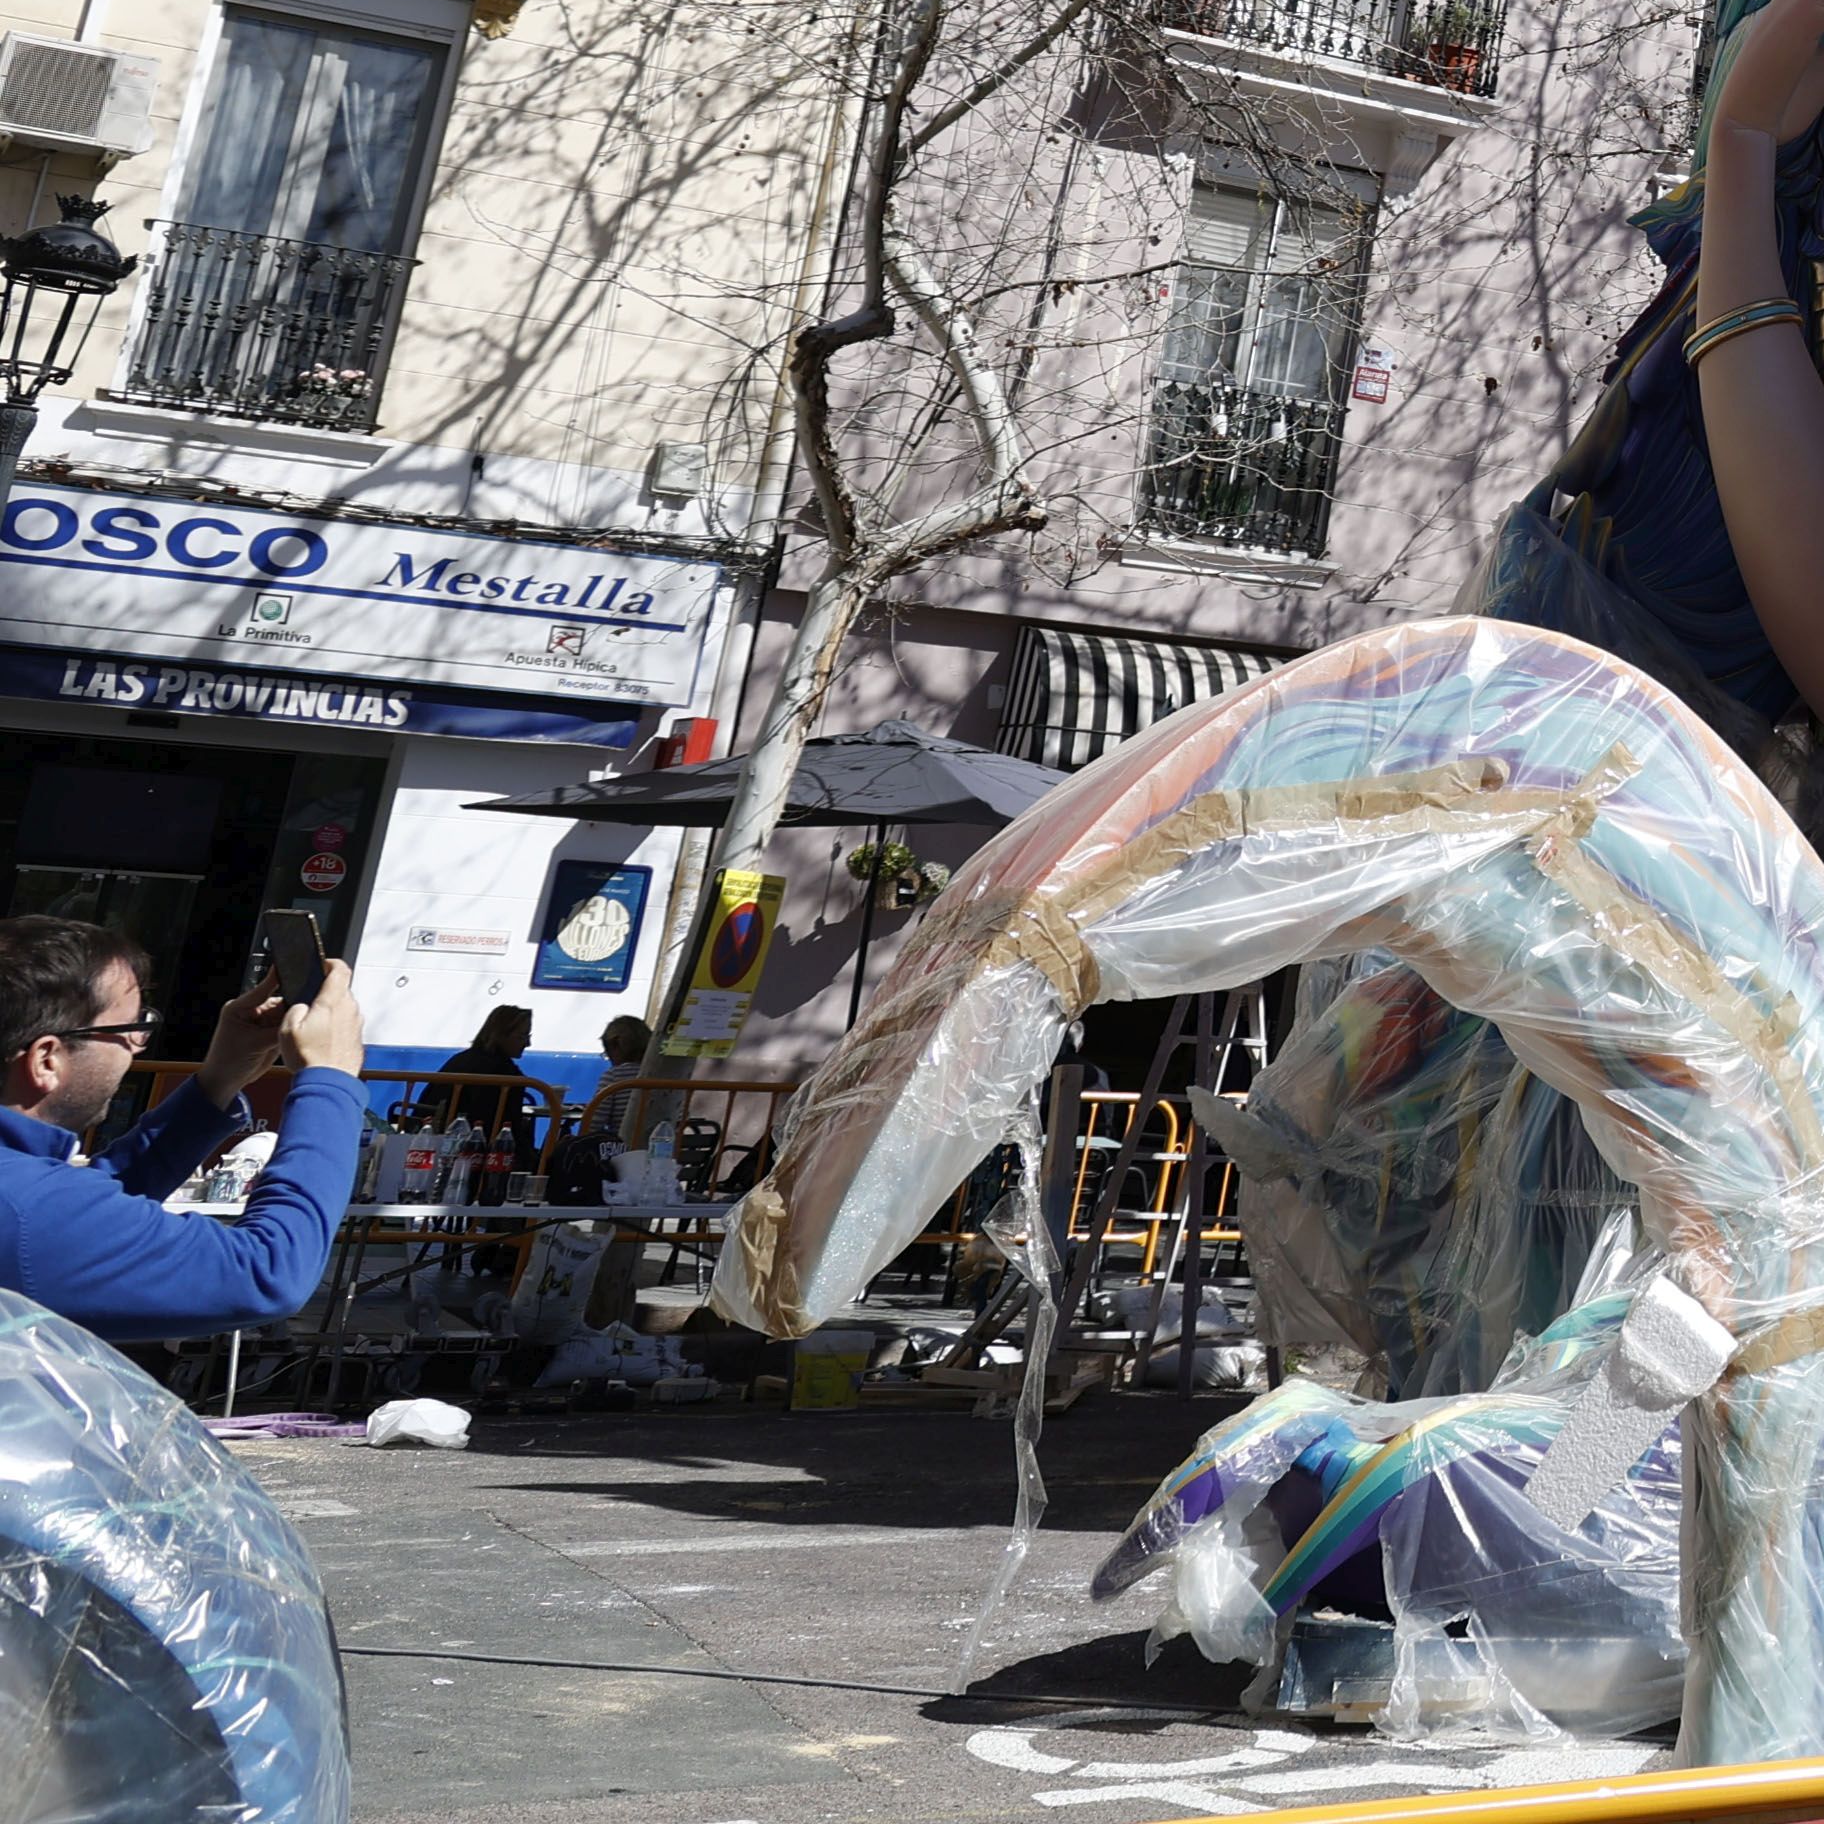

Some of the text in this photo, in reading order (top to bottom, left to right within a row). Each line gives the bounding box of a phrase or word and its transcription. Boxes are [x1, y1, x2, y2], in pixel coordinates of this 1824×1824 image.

[374, 552, 656, 616] Mestalla
[218, 623, 311, 644] La Primitiva
[504, 651, 617, 674] Apuesta Hípica
[59, 659, 412, 727] LAS PROVINCIAS
[557, 677, 610, 693] Receptor
